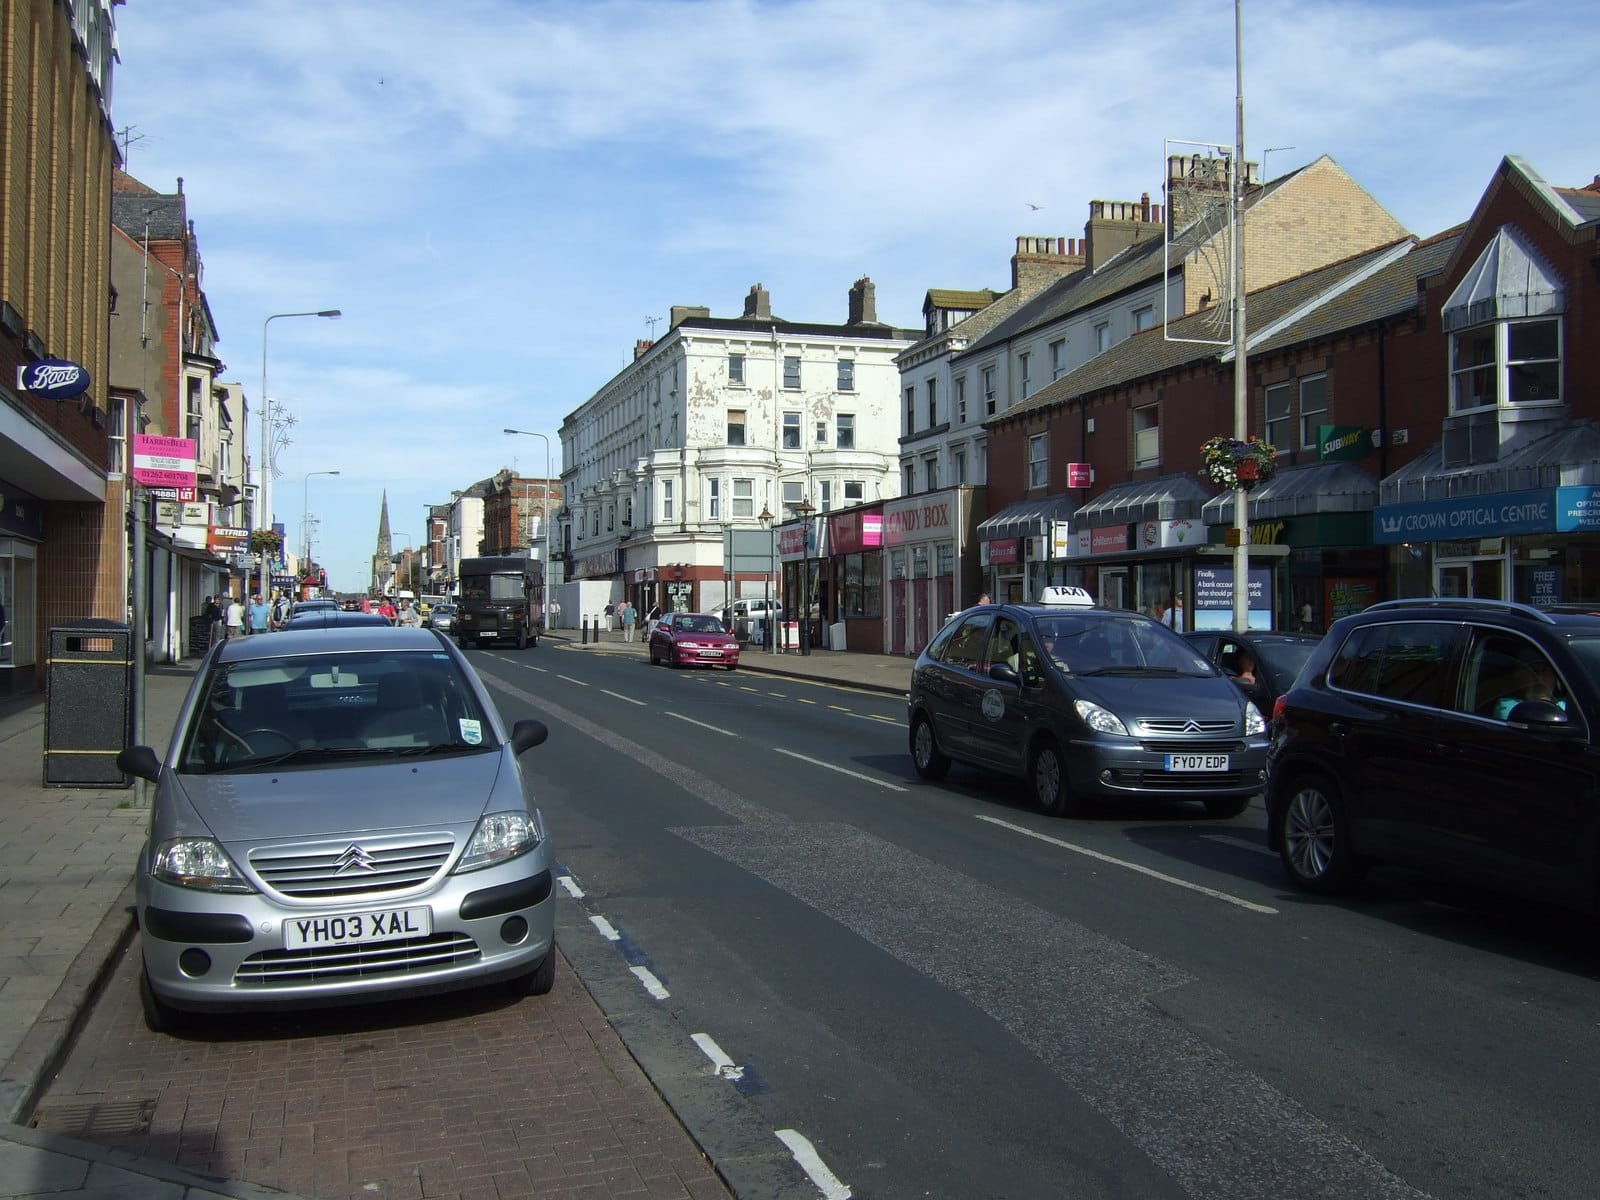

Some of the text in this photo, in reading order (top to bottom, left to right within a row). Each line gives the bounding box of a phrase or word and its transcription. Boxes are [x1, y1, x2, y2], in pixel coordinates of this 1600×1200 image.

[29, 365, 80, 390] Boots
[1323, 430, 1361, 454] SUBWAY
[180, 491, 193, 500] LET
[888, 503, 949, 534] CANDY BOX
[1405, 502, 1549, 530] CROWN OPTICAL CENTRE
[214, 528, 249, 537] BETFRED
[1533, 571, 1556, 582] FREE
[1203, 580, 1215, 588] bank
[1248, 581, 1262, 589] eople
[1535, 583, 1553, 594] EYE
[1050, 587, 1085, 597] TAXI
[1198, 589, 1209, 597] who
[1210, 589, 1227, 597] should
[1530, 595, 1558, 605] TESTS
[1173, 756, 1226, 769] FY07 EDP
[297, 911, 419, 943] YH03 XAL
